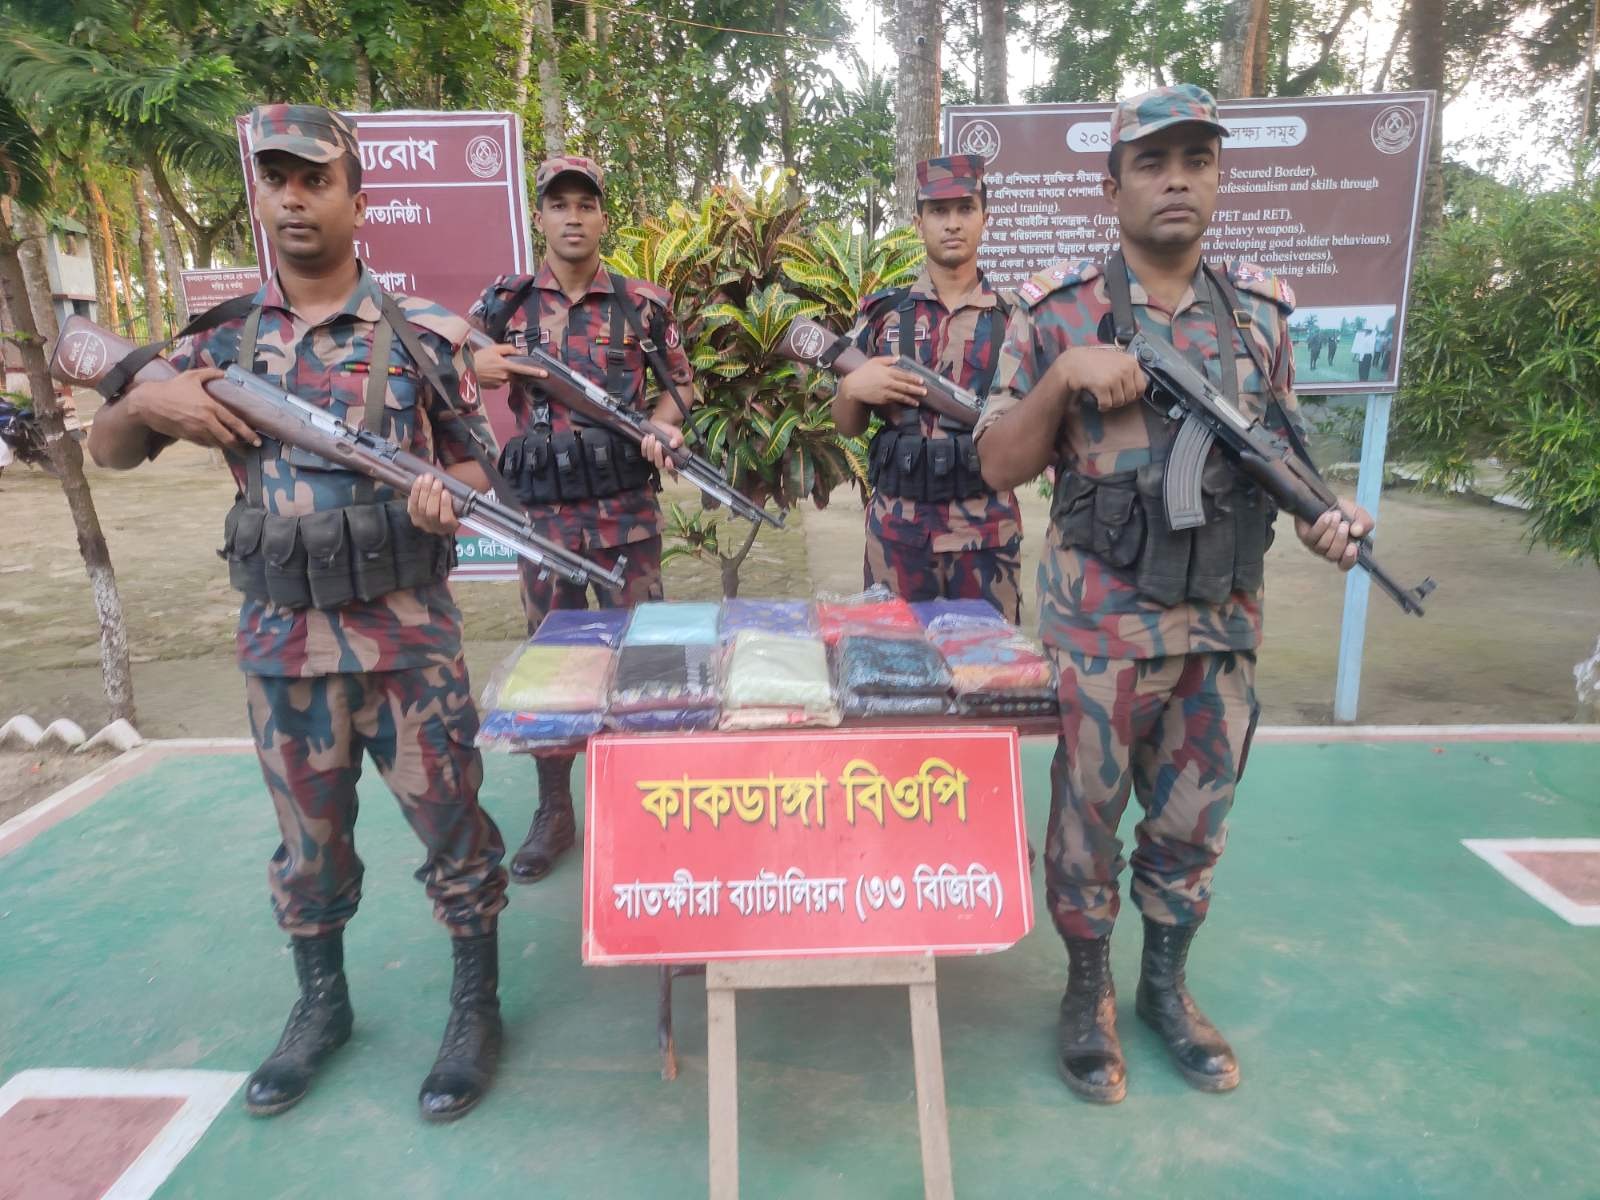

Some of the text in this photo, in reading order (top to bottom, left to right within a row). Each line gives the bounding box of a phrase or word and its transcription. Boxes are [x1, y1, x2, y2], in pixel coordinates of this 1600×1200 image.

[1079, 129, 1111, 147] ২০২
[1265, 123, 1299, 144] সমূহ
[358, 136, 439, 170] ্যবোধ
[1230, 167, 1272, 179] Secured
[1274, 165, 1317, 178] Border).
[1067, 183, 1104, 198] পেশাদারি
[1217, 176, 1379, 194] rofessionalism and skills through
[1019, 200, 1060, 214] traning).
[996, 218, 1013, 227] এবং
[1094, 212, 1120, 228] (Imp
[1219, 211, 1241, 222] PET
[1242, 210, 1261, 221] and
[1262, 208, 1293, 222] RET).
[1225, 224, 1254, 237] heavy
[1256, 222, 1305, 237] weapons).
[1212, 237, 1266, 252] developing
[1268, 236, 1294, 251] good
[1296, 234, 1330, 247] soldier
[1332, 232, 1392, 247] behaviours).
[1210, 253, 1236, 264] unity
[1238, 252, 1258, 263] and
[1260, 249, 1334, 262] cohesiveness).
[1305, 262, 1339, 276] skills).
[635, 756, 971, 832] কাকডাঙ্গা বিওপি
[613, 861, 1004, 922] সাতক্ষীরা ব্যাটালিয়ন (৩৩ বিজিবি)
